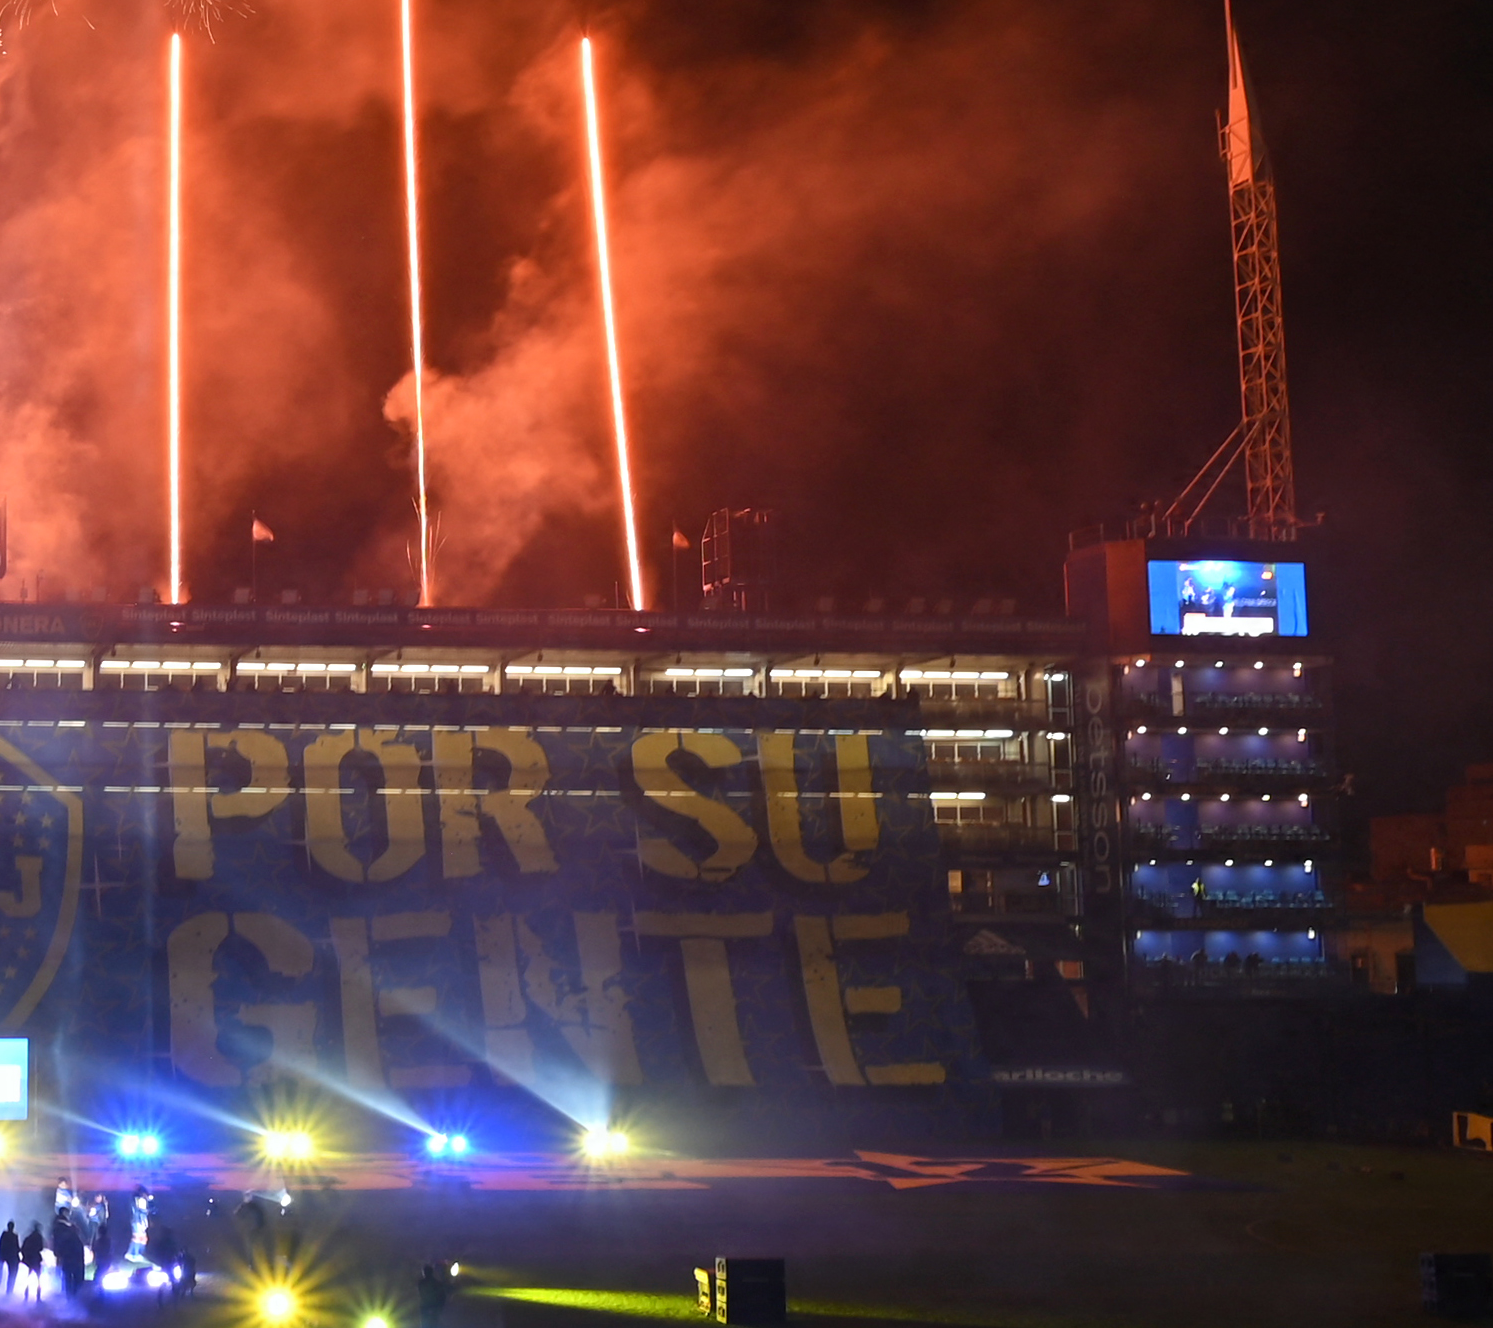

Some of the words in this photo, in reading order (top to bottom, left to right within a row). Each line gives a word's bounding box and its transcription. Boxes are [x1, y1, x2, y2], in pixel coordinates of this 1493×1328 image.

[191, 609, 257, 624] Sinteplast
[265, 610, 331, 625] Sinteplast
[334, 611, 400, 626] Sinteplast
[168, 725, 559, 882] POR
[630, 731, 881, 884] SU
[1086, 683, 1112, 893] betsson
[166, 909, 947, 1088] GENTE
